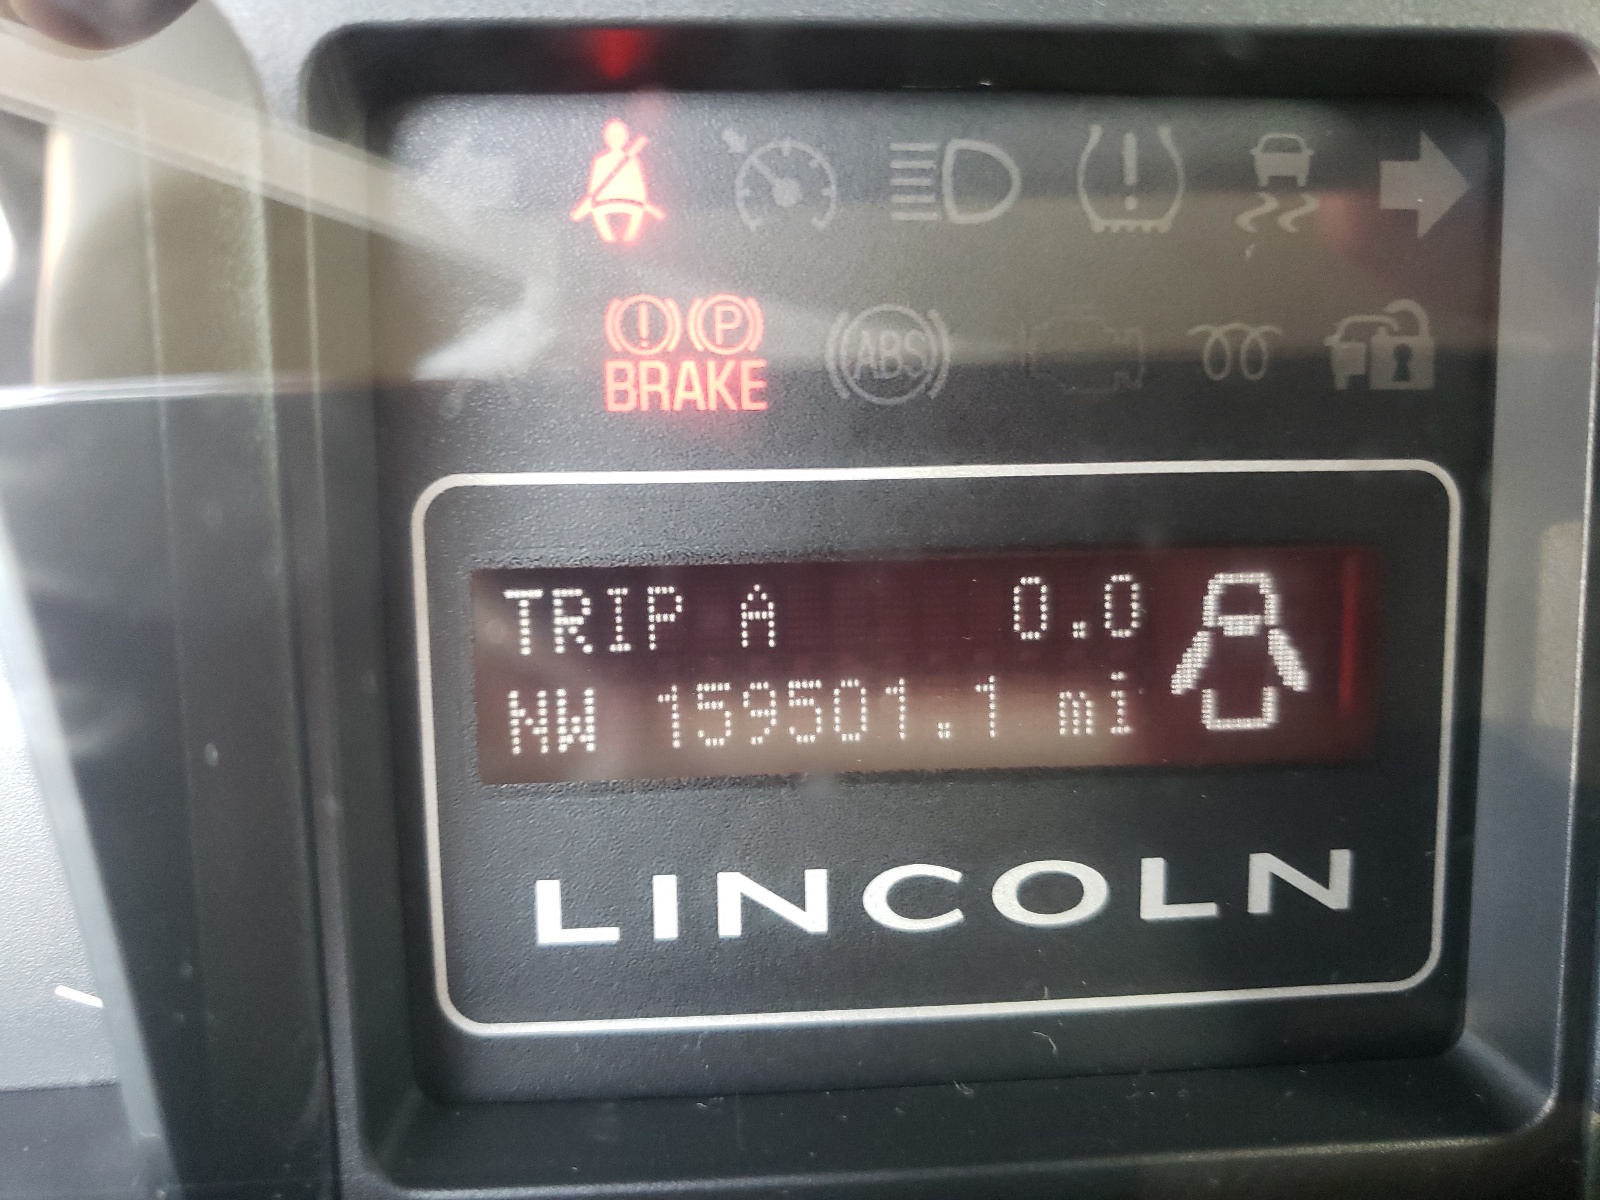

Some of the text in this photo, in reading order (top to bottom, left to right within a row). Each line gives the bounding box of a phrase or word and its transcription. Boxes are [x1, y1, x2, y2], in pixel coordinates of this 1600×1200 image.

[604, 359, 769, 412] BRAKE
[853, 330, 927, 380] ABS
[502, 573, 1140, 655] TRIP A 0.0
[507, 671, 1132, 755] NW 159501.1 mi
[535, 848, 1353, 946] LINCOLN
